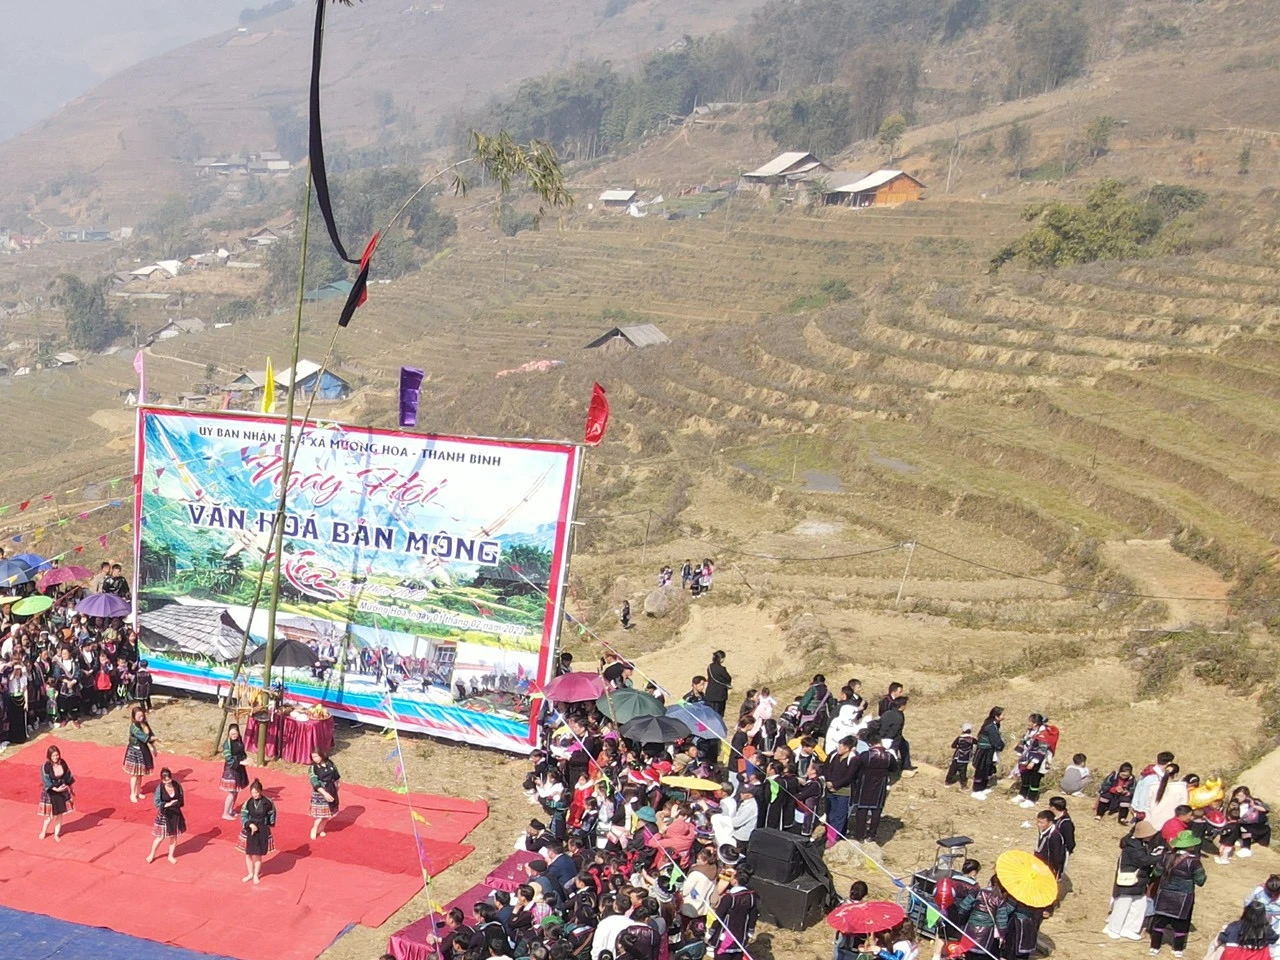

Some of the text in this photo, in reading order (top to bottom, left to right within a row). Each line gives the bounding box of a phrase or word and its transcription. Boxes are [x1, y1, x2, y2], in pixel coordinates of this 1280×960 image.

[217, 427, 240, 439] BAN
[243, 430, 276, 443] NHÂN
[309, 435, 326, 448] XÃ
[382, 444, 408, 457] HOA
[421, 448, 465, 463] THANH
[469, 451, 502, 467] BÌNH
[188, 502, 245, 530] VĂN
[255, 513, 319, 540] HOÁ
[405, 529, 499, 564] MÔNG
[433, 613, 443, 622] 01
[471, 619, 481, 629] 02
[504, 624, 525, 635] 2023
